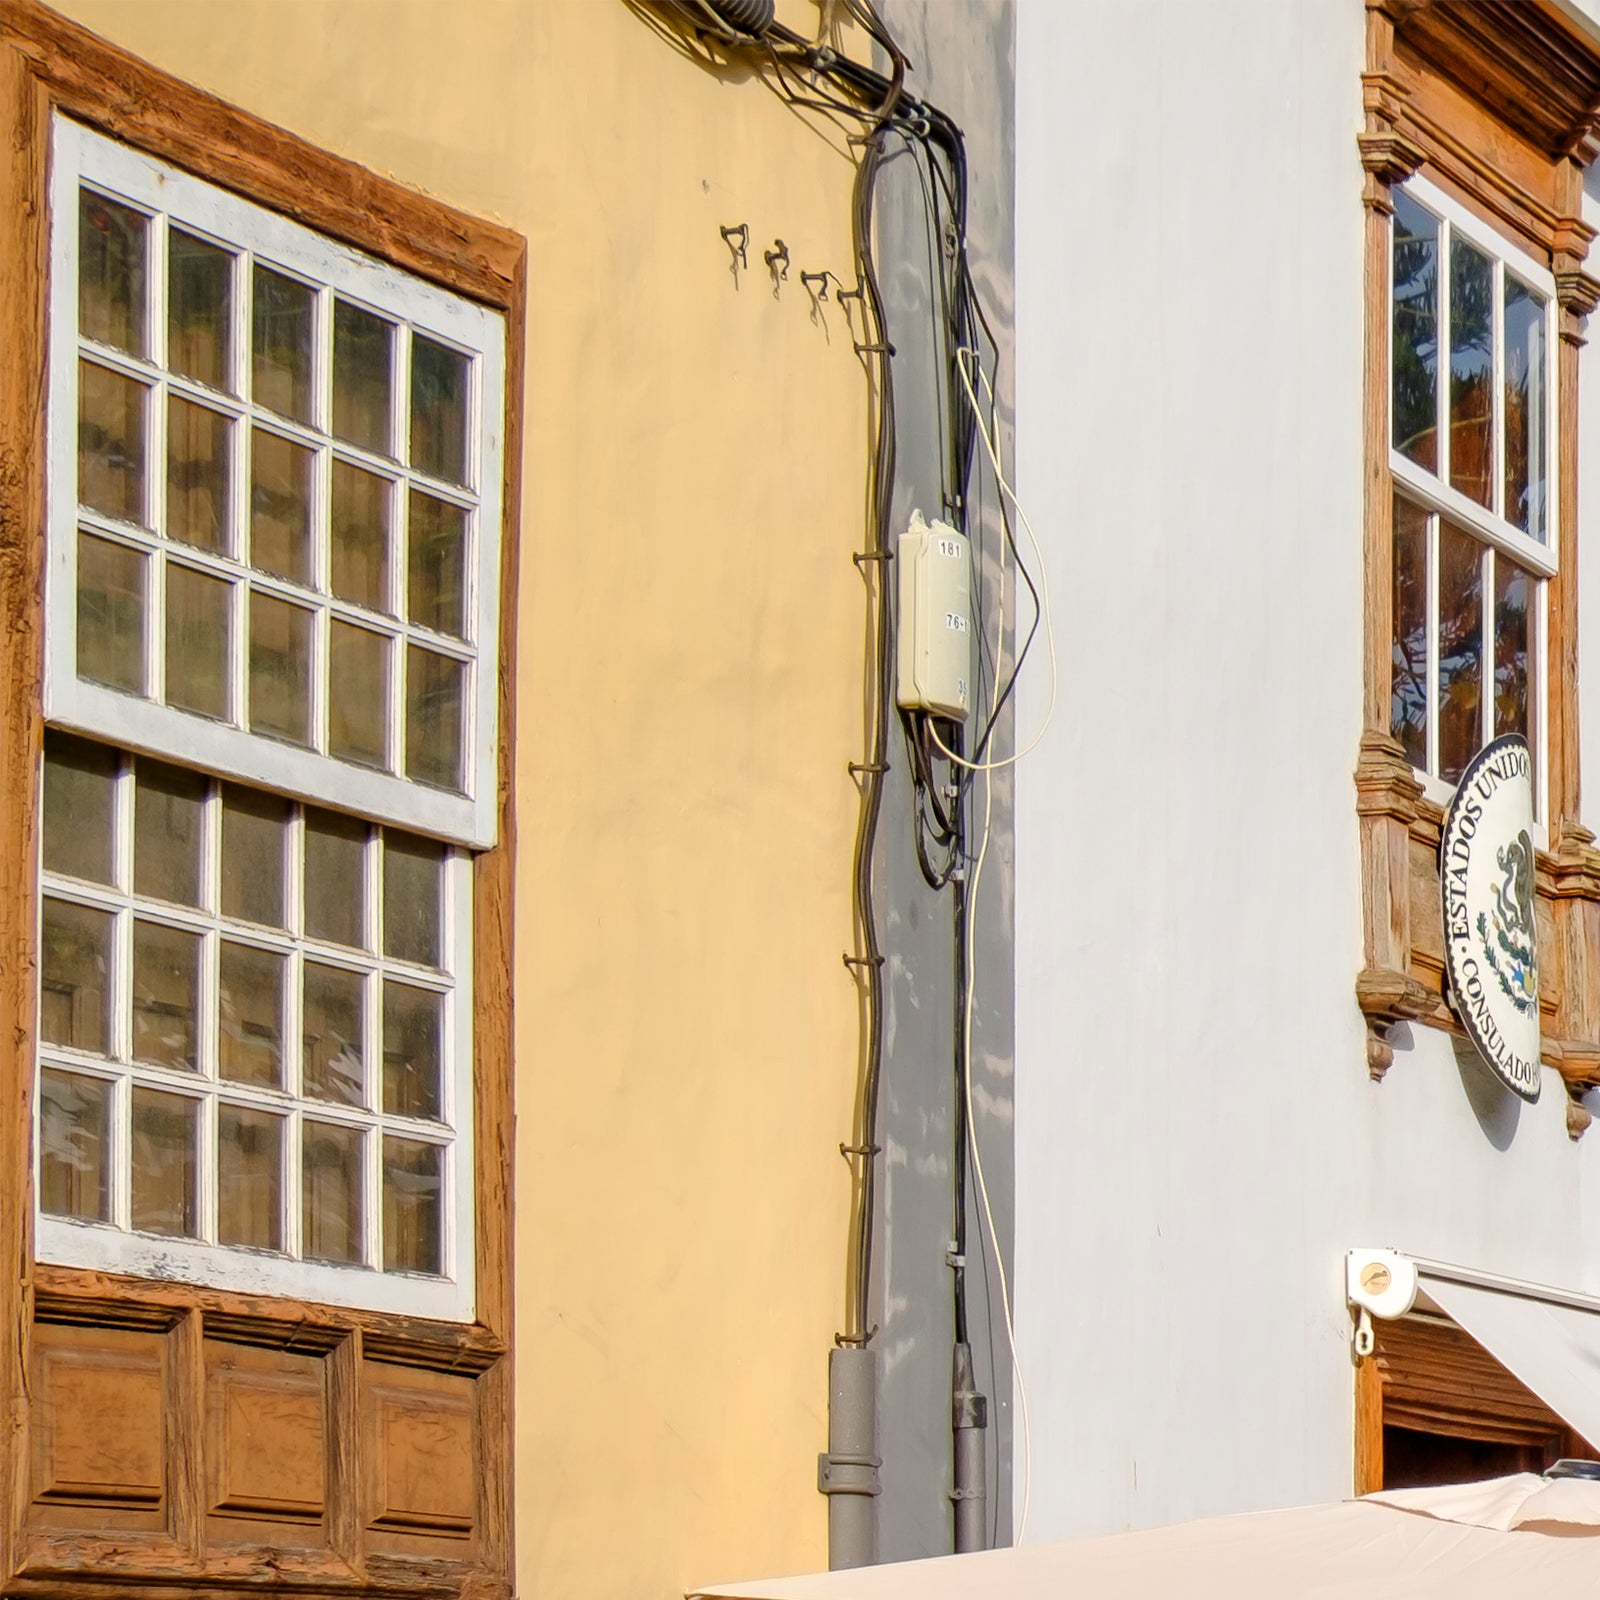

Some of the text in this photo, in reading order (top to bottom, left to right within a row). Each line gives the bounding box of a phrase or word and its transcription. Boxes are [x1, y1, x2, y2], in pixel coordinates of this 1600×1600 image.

[940, 542, 960, 557] 181
[1450, 797, 1483, 941] ESTADOS
[1462, 957, 1533, 1084] CONSULADO
